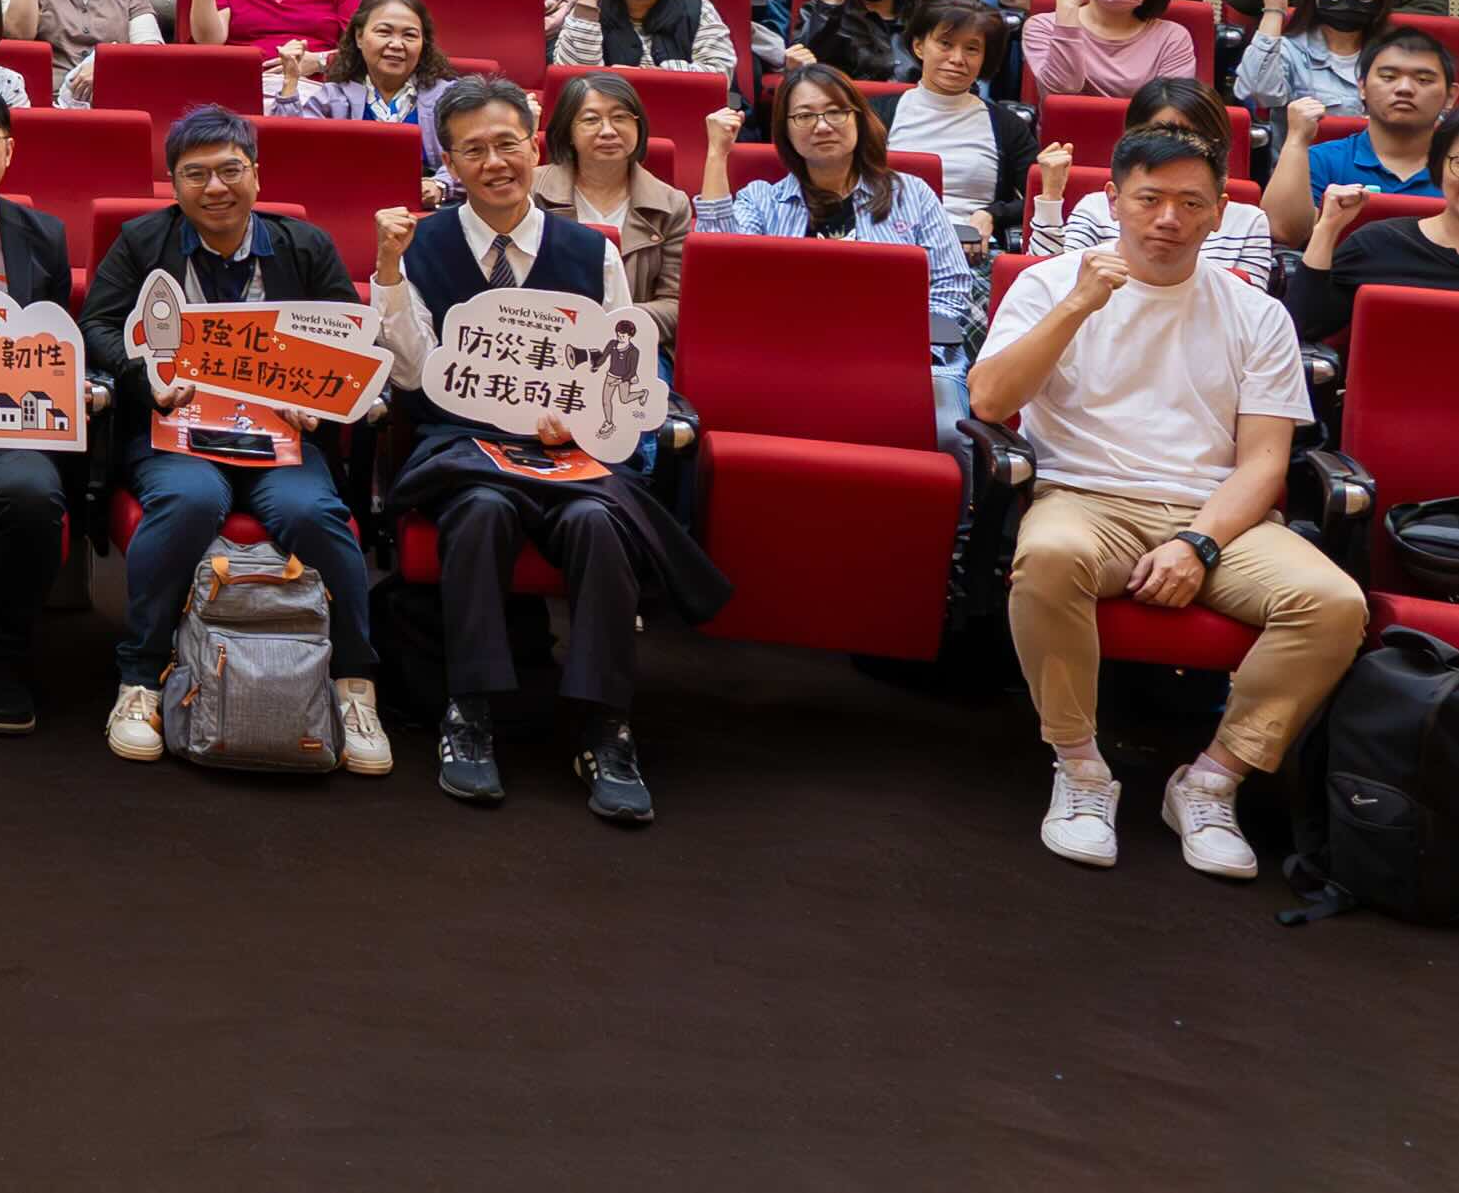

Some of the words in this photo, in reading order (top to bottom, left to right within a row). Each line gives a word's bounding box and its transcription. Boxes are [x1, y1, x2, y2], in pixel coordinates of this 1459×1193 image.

[291, 312, 321, 324] World
[323, 317, 352, 329] Vision
[499, 304, 531, 317] World
[533, 310, 565, 324] Vision
[202, 319, 269, 353] 強化
[458, 325, 558, 370] 防災事
[200, 352, 344, 399] 社區防災力
[443, 362, 586, 414] 你我的事
